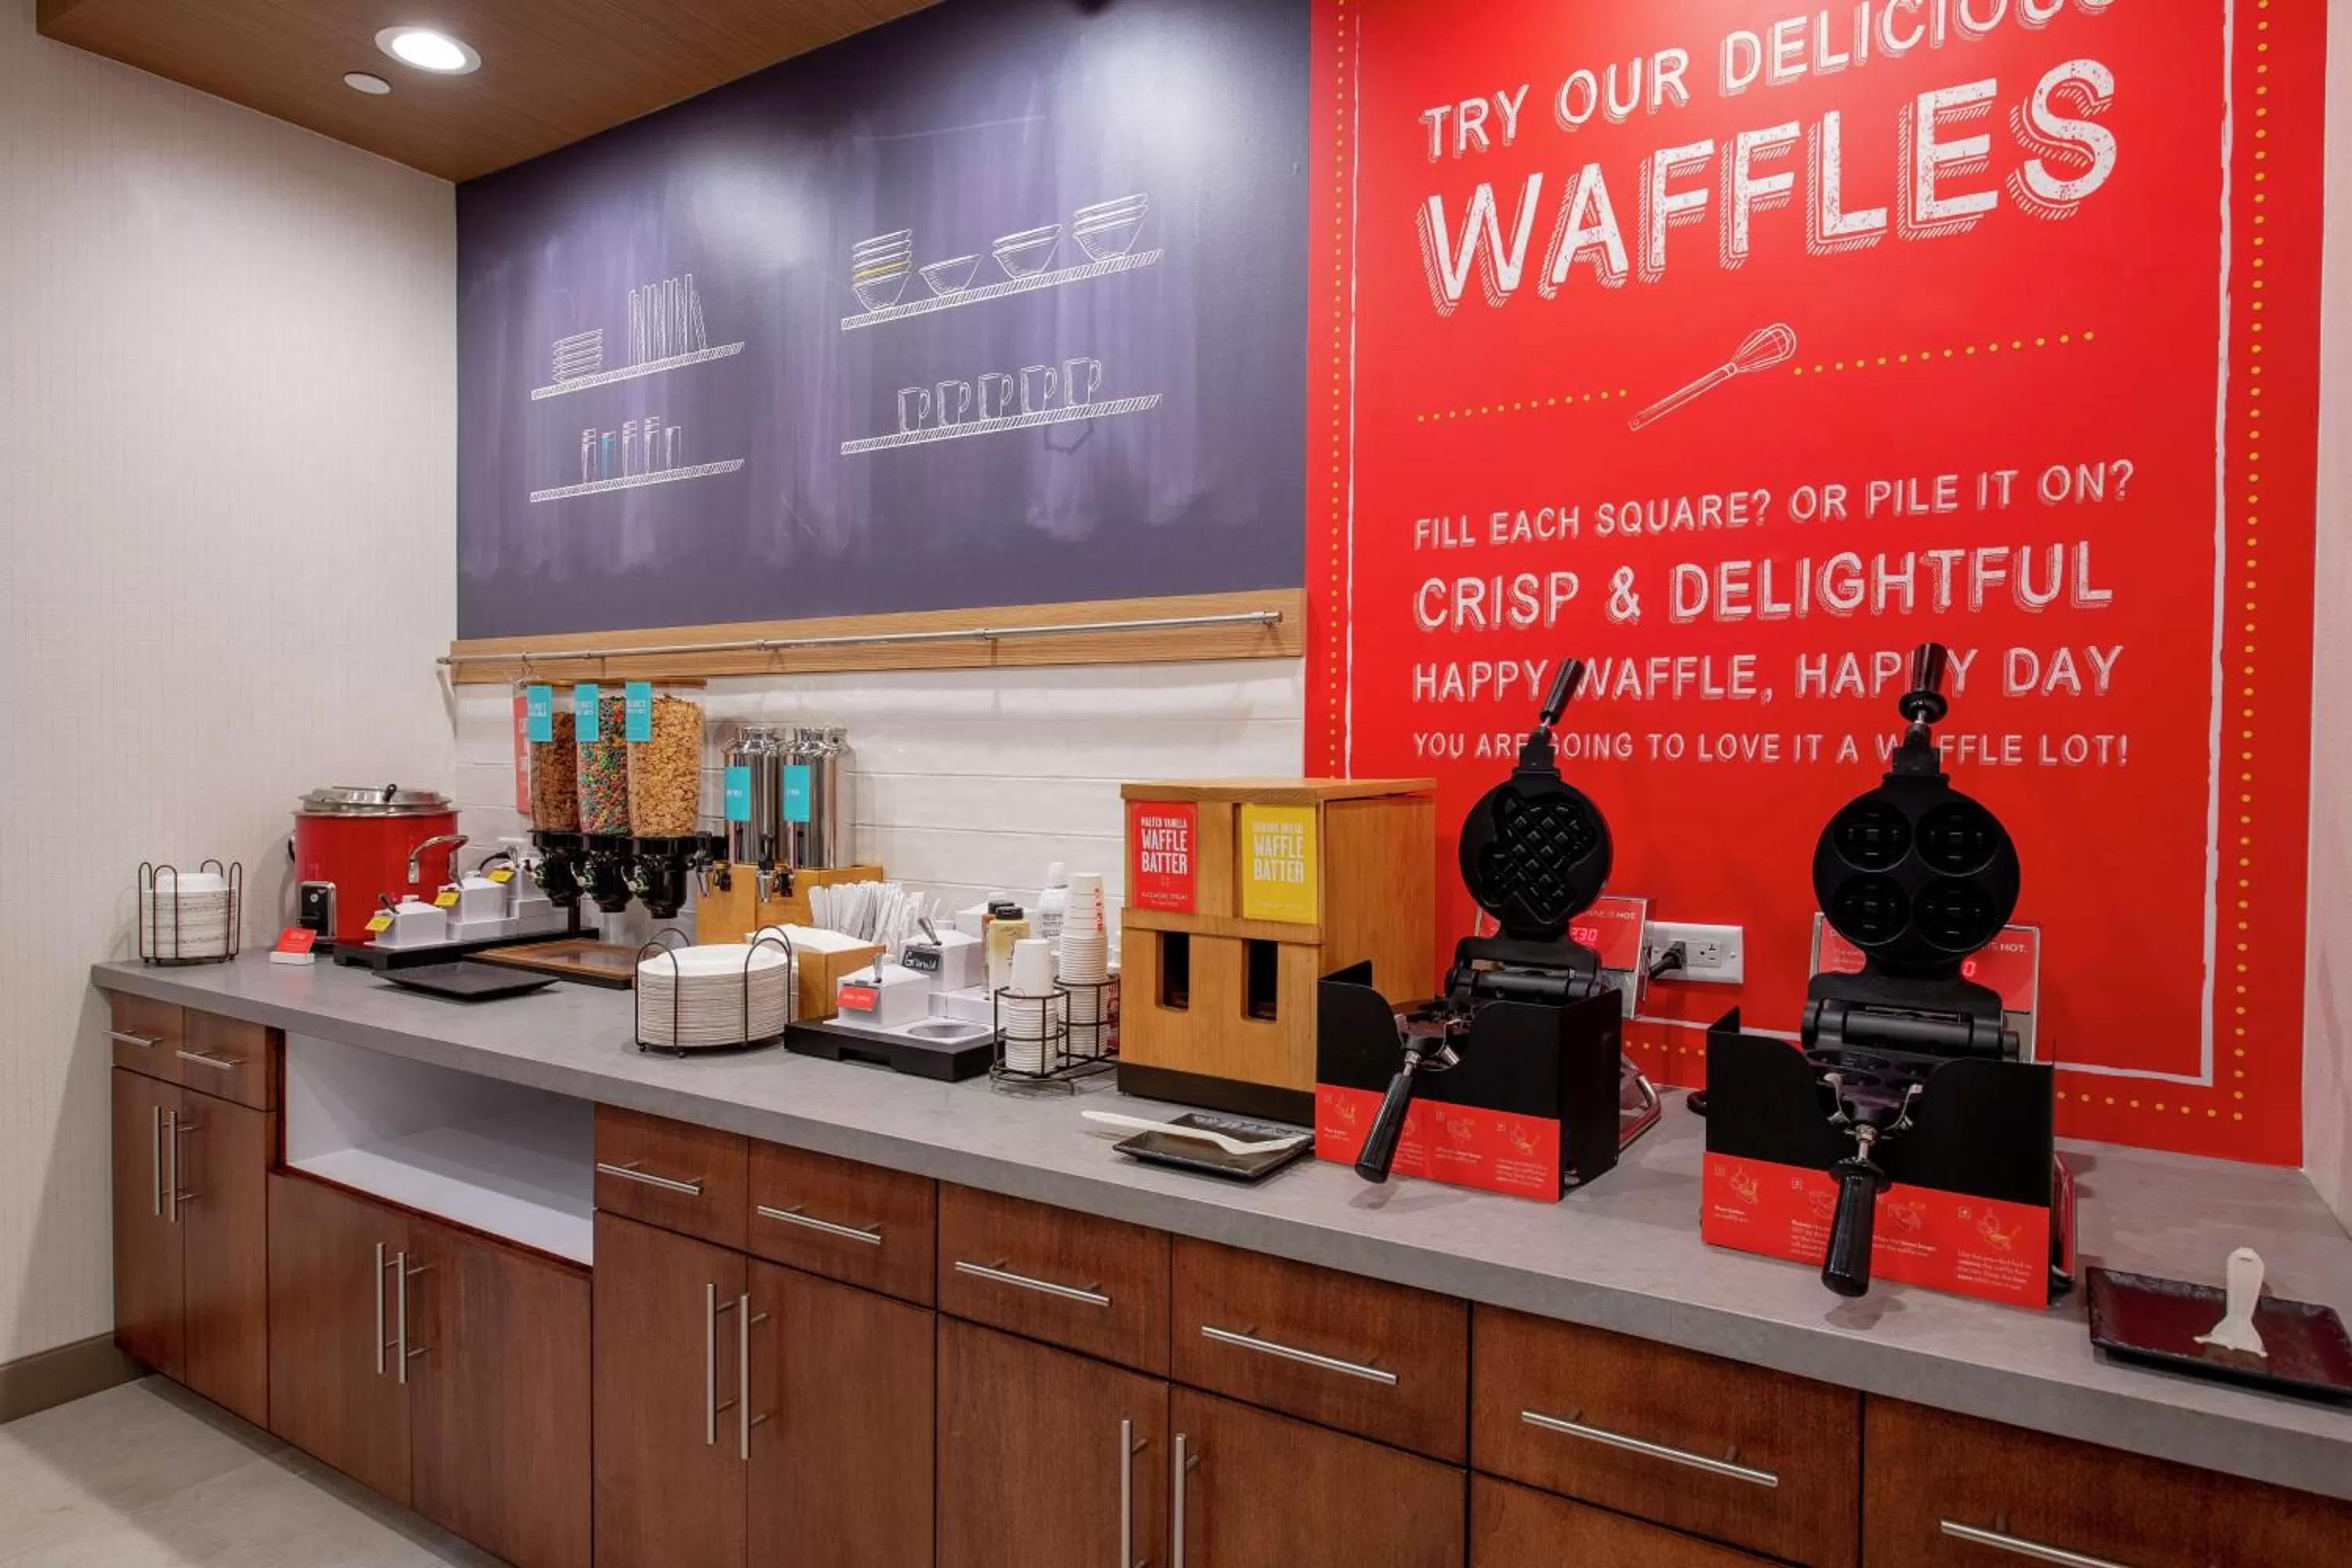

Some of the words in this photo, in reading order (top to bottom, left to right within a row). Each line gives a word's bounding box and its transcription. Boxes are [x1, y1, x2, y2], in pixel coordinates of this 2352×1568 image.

[1418, 85, 1530, 163] TRY
[1555, 49, 1690, 132] OUR
[1718, 0, 2115, 97] DELICIO
[1416, 55, 2117, 317] WAFFLES
[1414, 515, 1476, 550] FILL
[1490, 506, 1579, 544] EACH
[1595, 488, 1771, 537] SQUARE?
[1788, 484, 1847, 523] OR
[1866, 474, 1958, 517] PILE
[1977, 470, 2018, 510] IT
[2038, 459, 2133, 505] ON?
[1414, 572, 1579, 632] CRISP
[1606, 565, 1641, 625] &
[1669, 541, 2113, 623] DELIGHTFUL
[1413, 659, 1548, 702] HAPPY
[1570, 654, 1773, 704] WAFFLE,
[1795, 646, 1978, 698] HAPY
[2004, 645, 2123, 696] DAY
[1414, 732, 1464, 759] YOU
[1475, 733, 1526, 761] ARE
[1647, 732, 1685, 760] TO
[1698, 733, 1780, 762] LOVE
[1795, 734, 1822, 762] IT
[1837, 734, 1858, 764] A
[1875, 733, 2023, 765] WFFLE
[2040, 734, 2127, 765] LOT!
[1141, 828, 1188, 852] WAFFLE
[1254, 833, 1304, 858] WAFFLE
[1141, 851, 1188, 876] BATTER
[1254, 858, 1305, 883] BATTER
